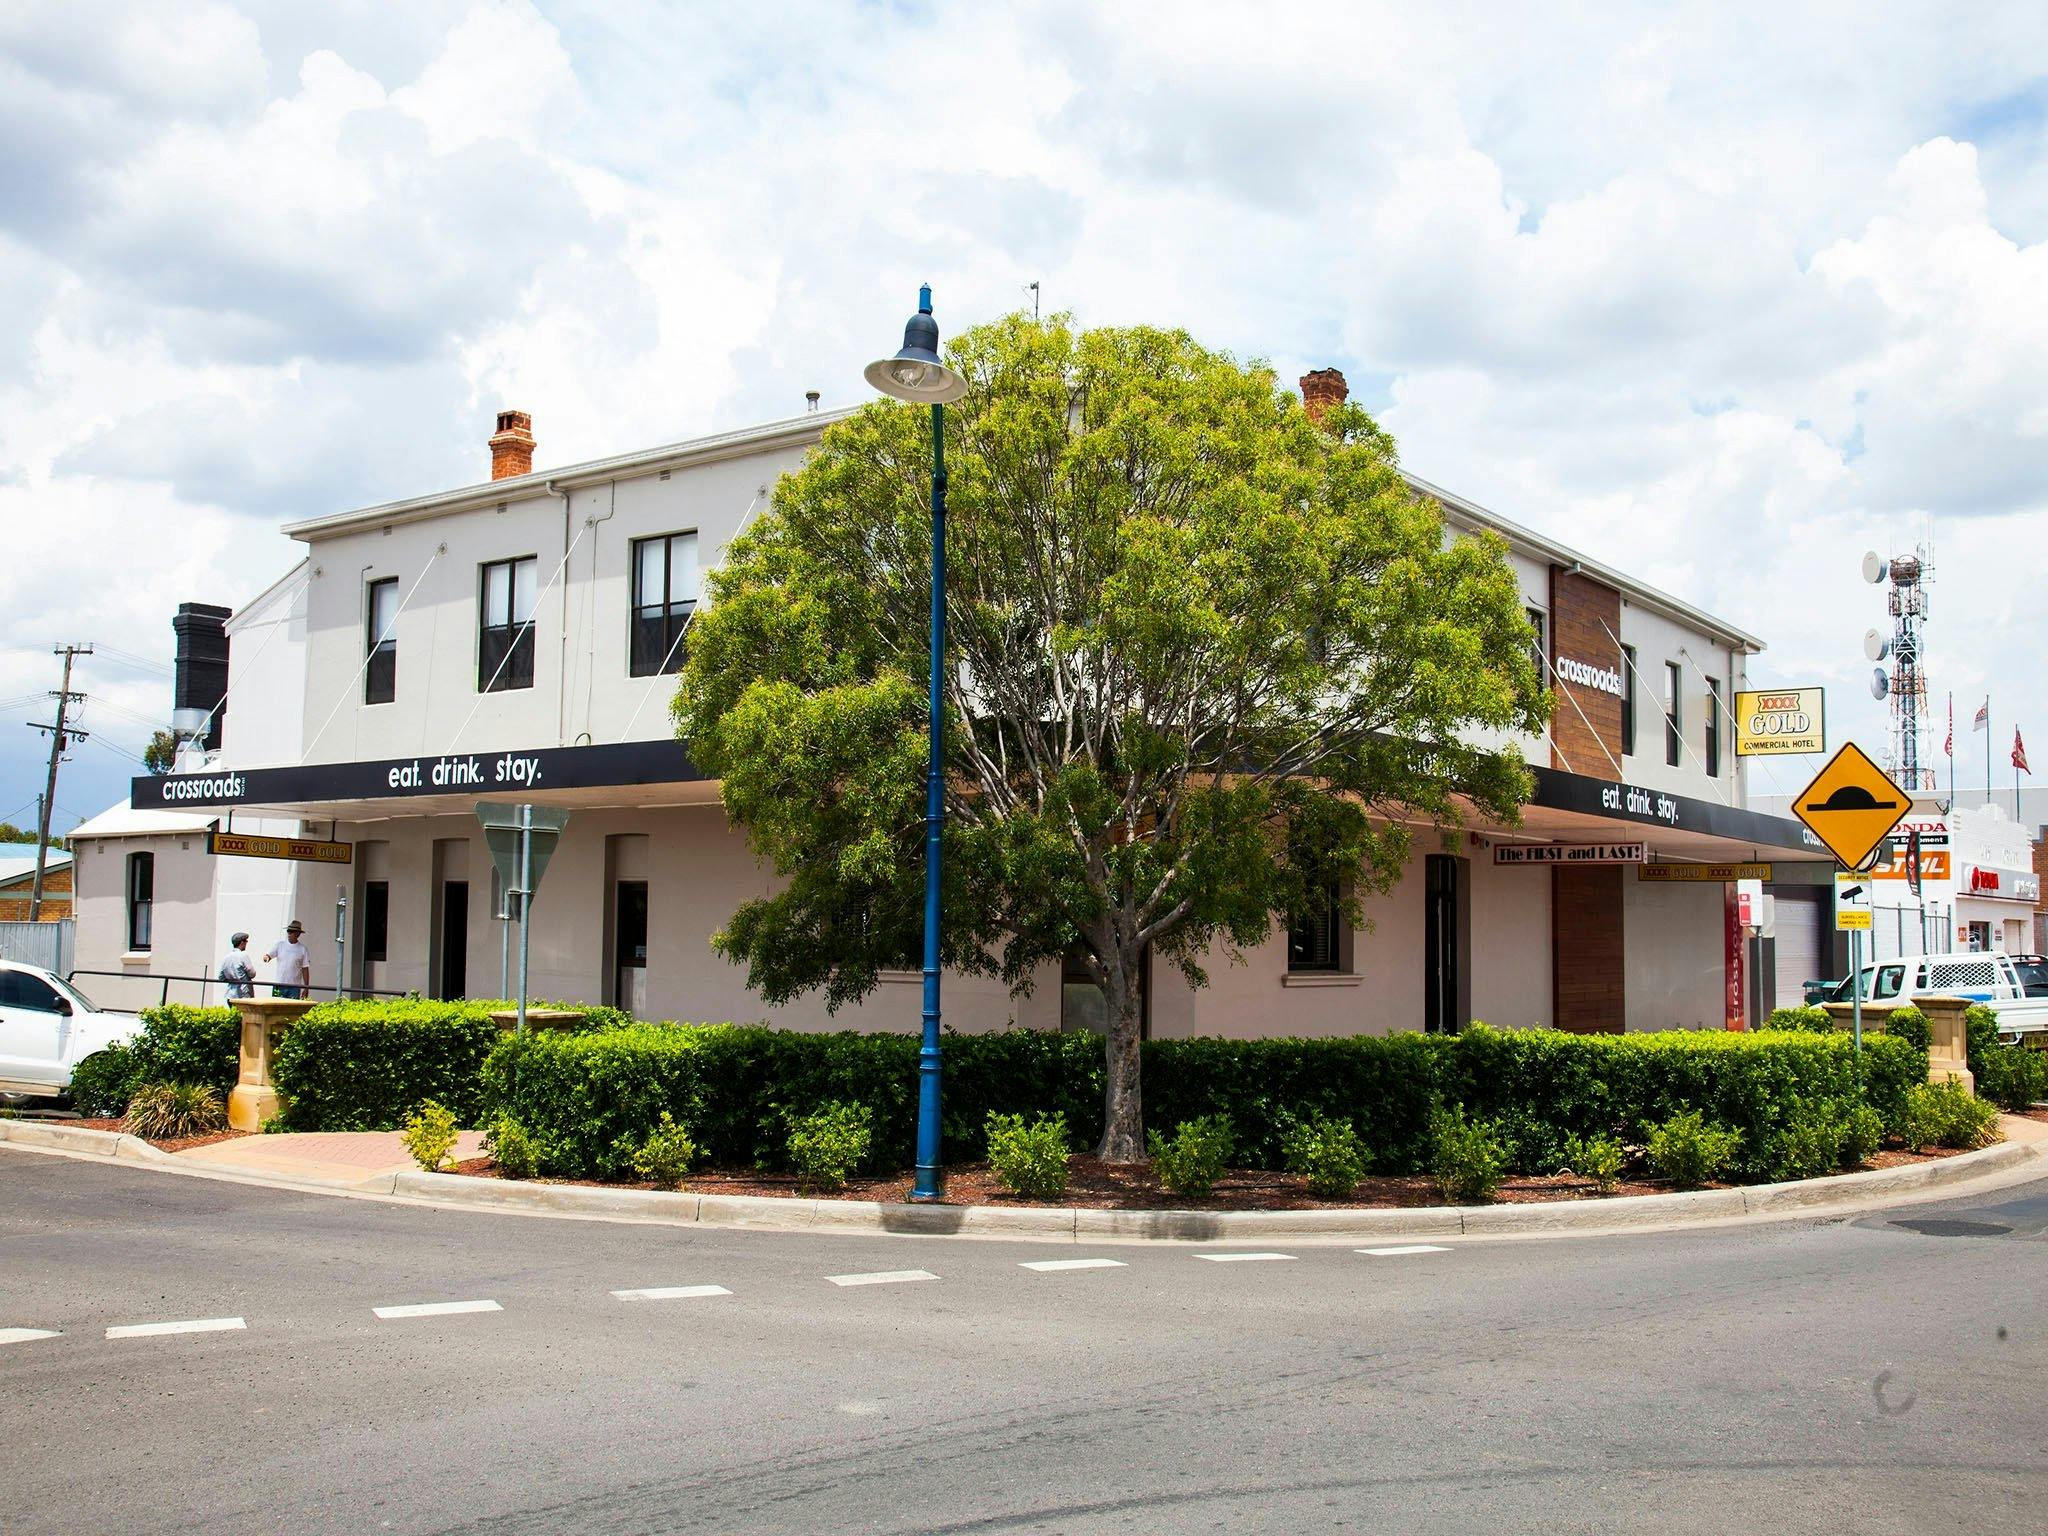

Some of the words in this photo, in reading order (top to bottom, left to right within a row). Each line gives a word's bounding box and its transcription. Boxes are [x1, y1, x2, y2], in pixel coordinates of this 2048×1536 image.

[1556, 656, 1619, 695] crossroads
[1762, 696, 1797, 710] XXXX
[1749, 712, 1810, 735] GOLD
[1744, 740, 1790, 750] COMMERCIAL
[1792, 739, 1815, 748] HOTEL
[388, 761, 422, 788] eat.
[432, 756, 485, 786] drink.
[495, 754, 542, 787] stay.
[163, 772, 241, 800] crossroads
[1602, 785, 1622, 810] eat.
[1627, 787, 1653, 816] drink.
[1658, 794, 1679, 824] stay.
[1891, 823, 1948, 832] ONDA
[222, 839, 246, 851] XXXX
[250, 840, 280, 854] GOLD
[291, 844, 314, 855] XXXX
[319, 847, 346, 858] GOLD
[1498, 848, 1523, 861] The
[1526, 847, 1564, 860] FIRST
[1568, 846, 1595, 859] and
[1598, 845, 1640, 859] LAST!
[1646, 867, 1668, 877] XXXX
[1672, 867, 1700, 878] GOLD
[1710, 867, 1732, 877] XXXX
[1737, 866, 1766, 878] GOLD
[1875, 857, 1944, 873] STHL
